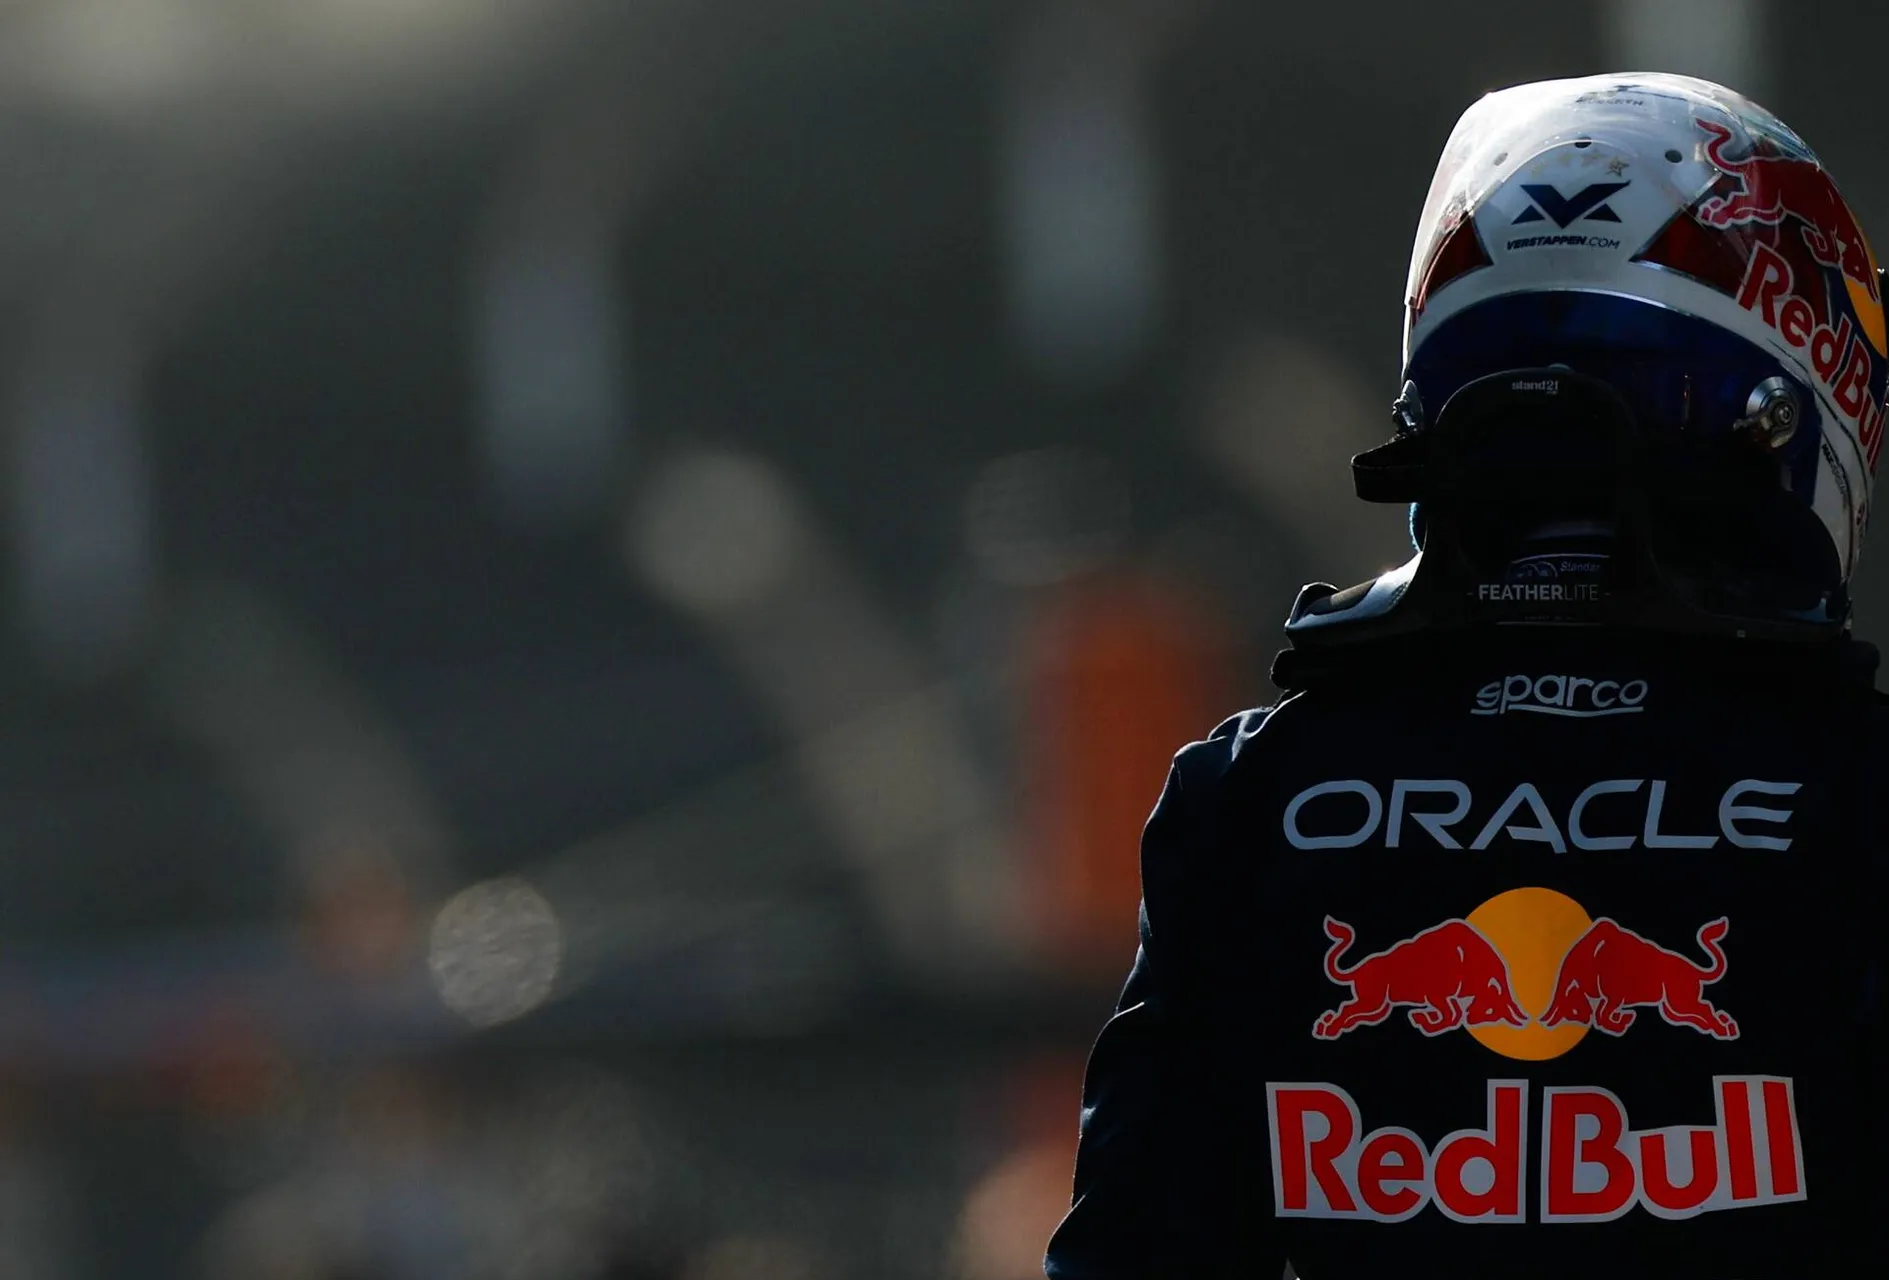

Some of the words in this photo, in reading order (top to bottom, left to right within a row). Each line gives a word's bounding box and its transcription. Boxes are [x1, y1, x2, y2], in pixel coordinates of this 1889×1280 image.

[1506, 235, 1621, 251] VERSTAPPEN.COM
[1735, 240, 1853, 384] Red
[1478, 584, 1600, 601] FEATHERLITE
[1471, 674, 1649, 716] sparco
[1283, 779, 1803, 854] ORACLE
[1266, 1079, 1528, 1223] Red
[1540, 1074, 1807, 1223] Bull
